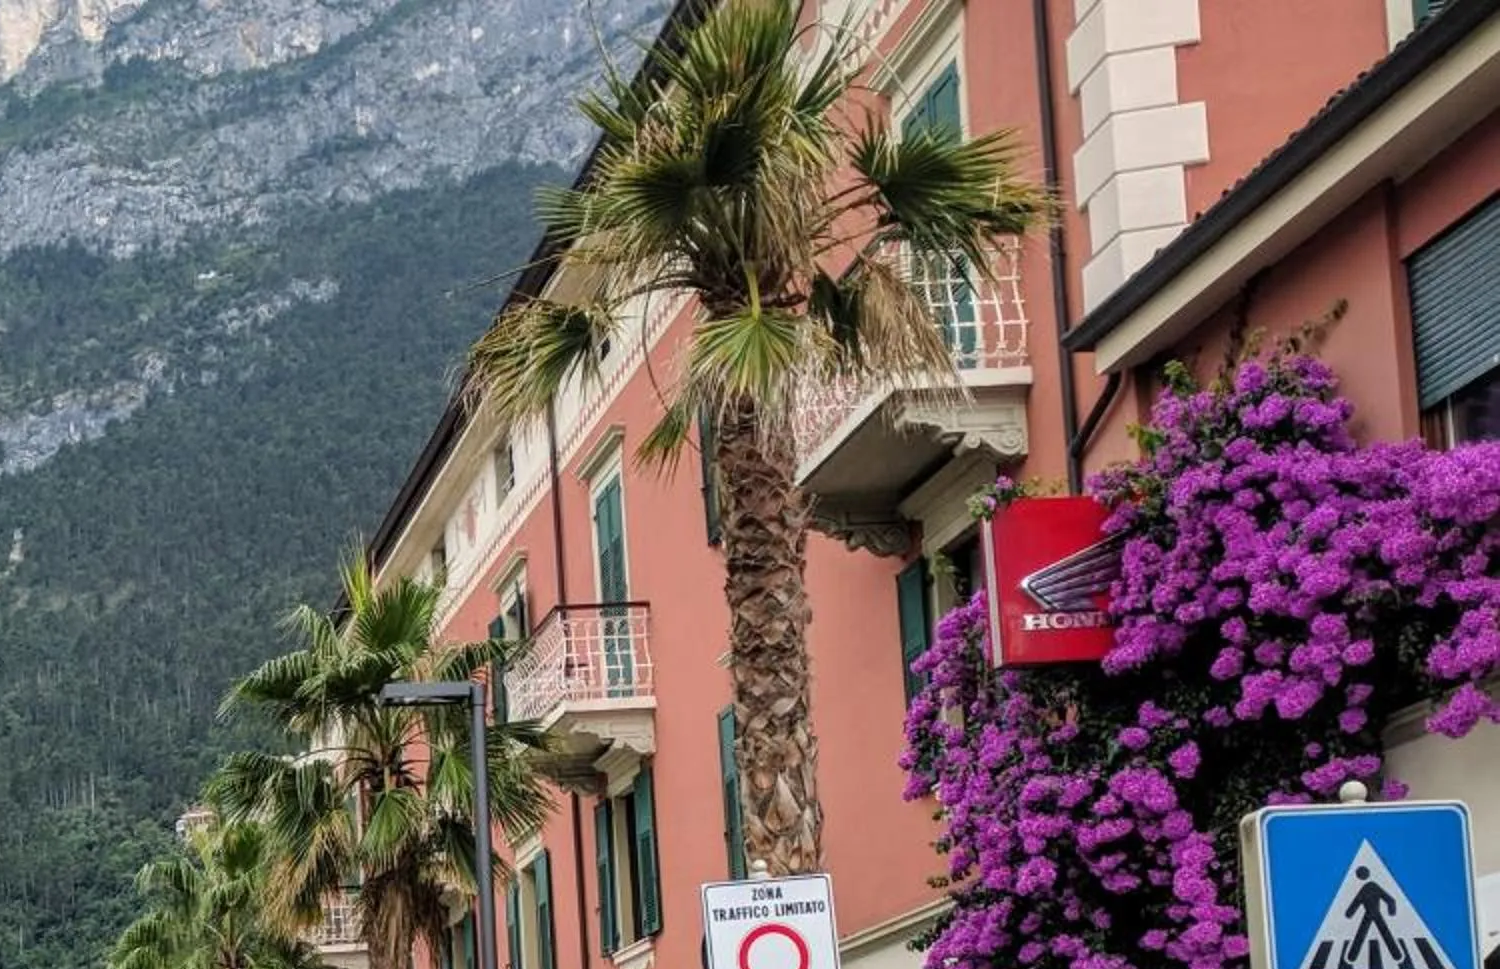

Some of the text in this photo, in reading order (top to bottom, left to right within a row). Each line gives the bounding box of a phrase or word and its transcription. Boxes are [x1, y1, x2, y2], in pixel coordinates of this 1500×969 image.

[1021, 610, 1106, 631] HON
[752, 887, 783, 901] ZONA
[712, 901, 825, 922] TRAFFICO LIMITATO
